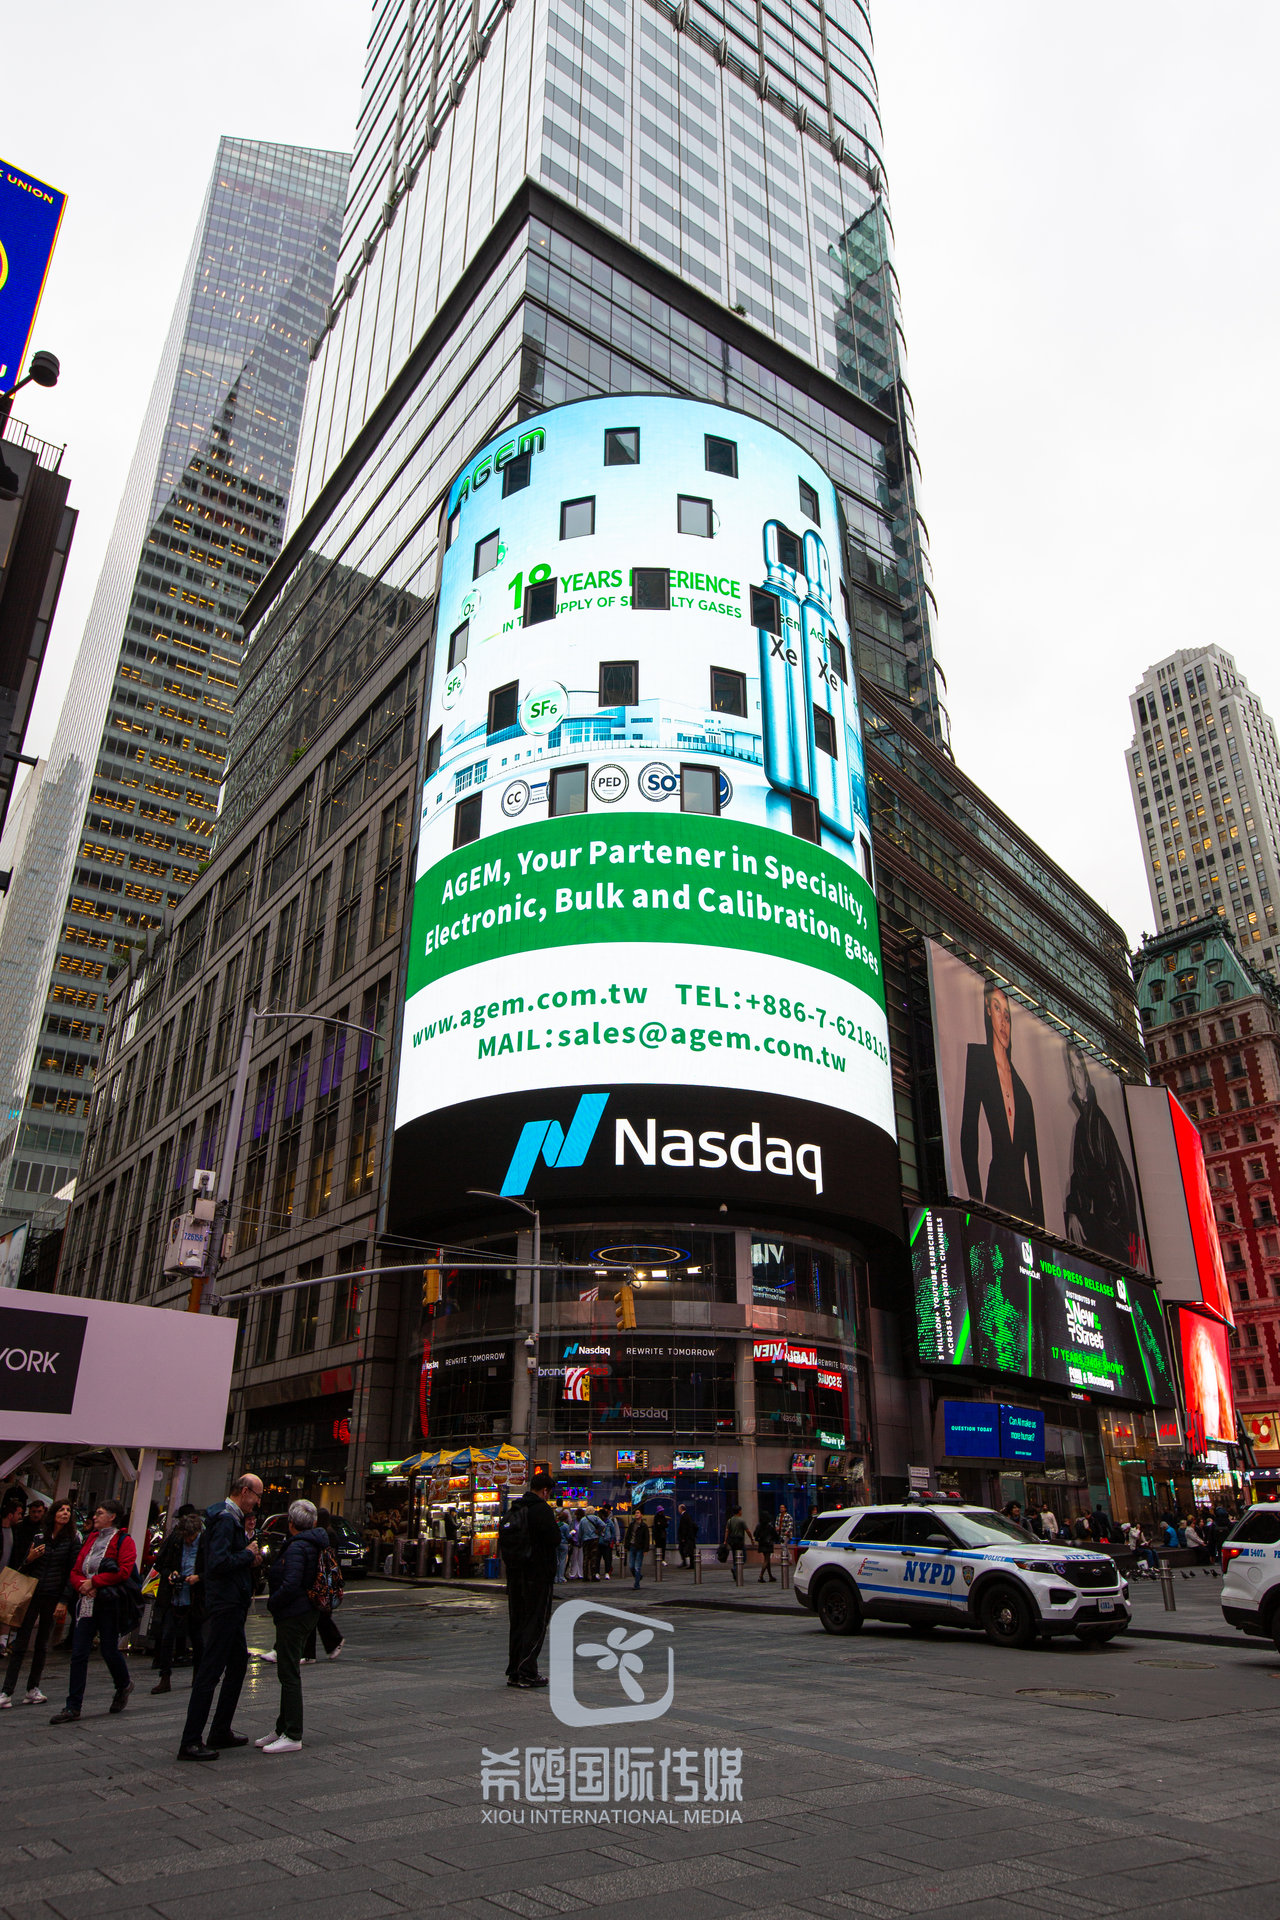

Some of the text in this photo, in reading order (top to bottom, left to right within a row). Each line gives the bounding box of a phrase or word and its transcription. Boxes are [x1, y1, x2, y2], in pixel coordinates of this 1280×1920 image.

[7, 173, 54, 205] UNION
[559, 569, 623, 594] YEARS
[629, 568, 741, 600] ERIENCE
[556, 597, 593, 615] PPLY
[597, 596, 616, 608] OF
[698, 599, 742, 619] GASES
[503, 619, 514, 634] IN
[770, 634, 798, 667] Xe
[446, 676, 461, 697] SF6
[817, 656, 838, 692] Xe
[530, 699, 558, 719] SF6
[598, 777, 622, 788] PED
[506, 791, 522, 806] CC
[441, 840, 867, 930] AGEM, Your Partener in Speciality,
[424, 882, 879, 976] Electronic, Bulk and Calibration gases
[412, 983, 648, 1048] www.agem.com.tw
[614, 1118, 824, 1195] Nasdaq
[925, 1210, 937, 1267] SUBSCRIBERS
[930, 1269, 940, 1309] YOUTUBE
[936, 1217, 955, 1355] ACROSS OUR DIGITAL CHANNELS
[1040, 1259, 1115, 1298] VIDEO PRESS RELEASES
[1075, 1322, 1105, 1350] Street
[578, 1345, 716, 1357] Nasdaq REWRITE TOMORROW
[1051, 1346, 1060, 1359] 17
[622, 1406, 669, 1421] Nasdaq
[983, 1553, 1006, 1563] POLICE
[903, 1560, 956, 1587] NYPD
